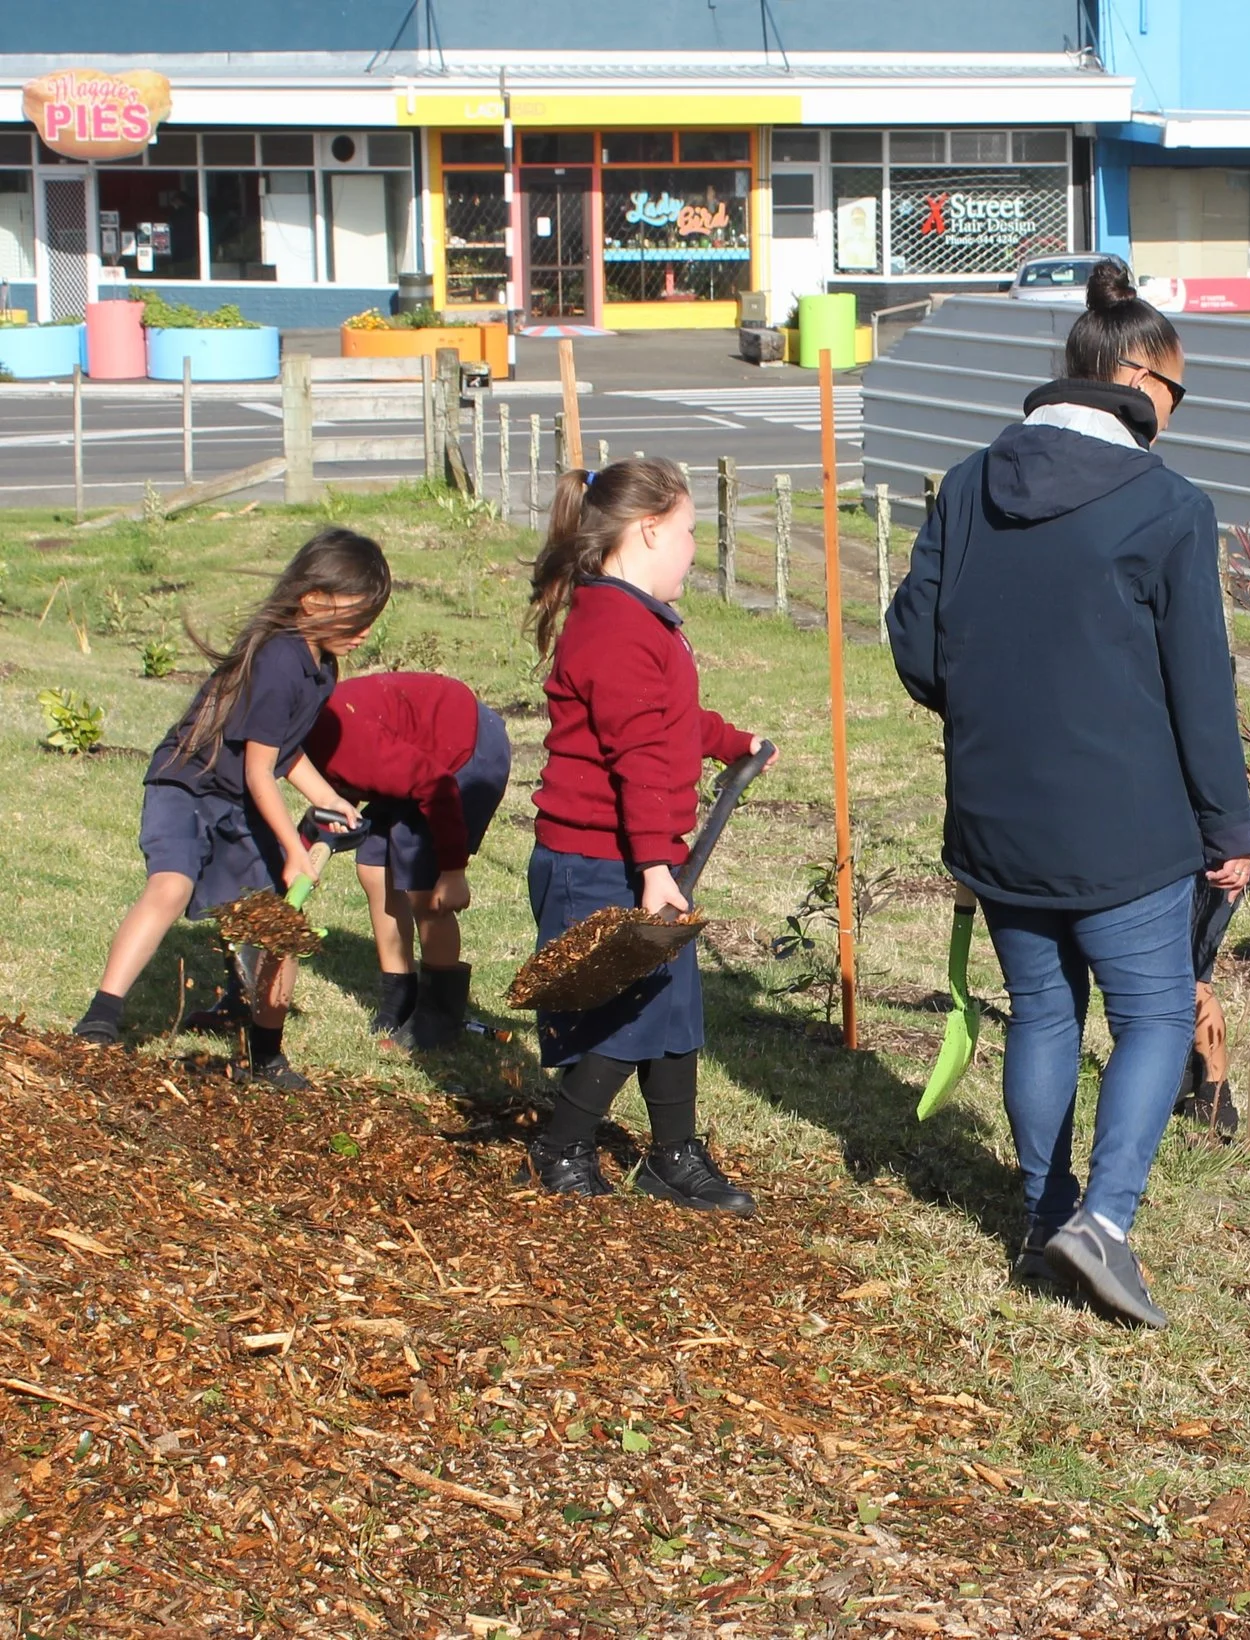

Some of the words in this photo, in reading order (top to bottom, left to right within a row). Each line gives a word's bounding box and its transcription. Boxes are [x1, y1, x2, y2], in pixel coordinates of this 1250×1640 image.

[48, 72, 140, 104] Maggies
[45, 102, 150, 141] PIES
[626, 192, 684, 227] Lady
[677, 202, 729, 236] Bird
[921, 192, 949, 235] X
[950, 193, 1025, 219] Street
[951, 219, 982, 233] Hair
[987, 219, 1036, 236] Design
